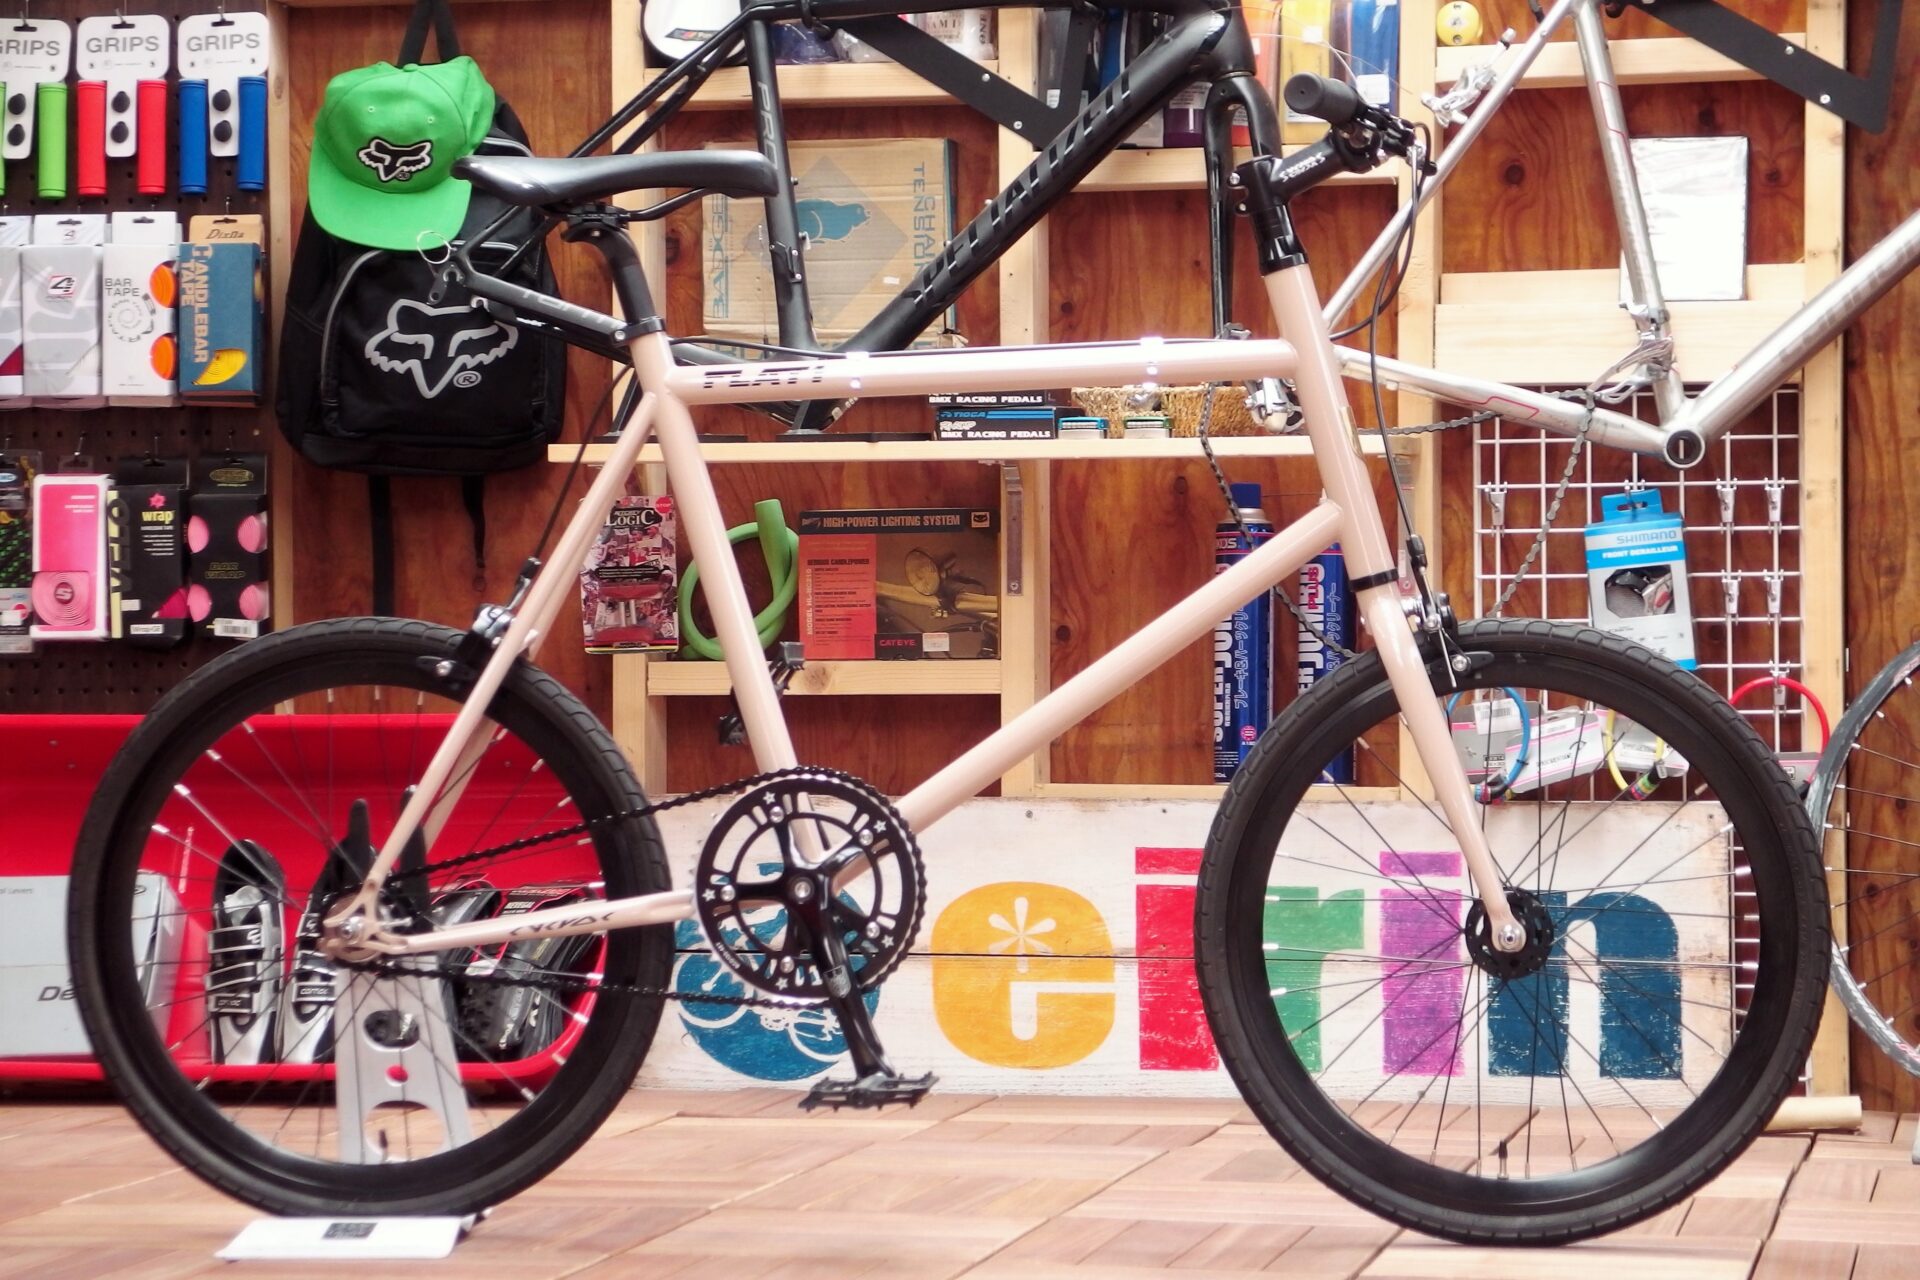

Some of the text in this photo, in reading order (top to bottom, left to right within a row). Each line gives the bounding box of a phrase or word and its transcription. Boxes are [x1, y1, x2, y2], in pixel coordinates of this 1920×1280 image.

[86, 36, 160, 53] GRIPS
[186, 33, 261, 52] GRIPS
[756, 81, 779, 169] PRO
[105, 278, 132, 287] BAR
[181, 258, 194, 307] TAPE
[105, 287, 140, 297] TAPE
[192, 244, 213, 363] HANDLEBAR
[955, 395, 996, 404] RACING
[1001, 394, 1043, 403] PEDALS
[967, 430, 1006, 439] RACING
[1010, 429, 1051, 438] PEDALS
[142, 510, 174, 526] wrap
[823, 515, 879, 528] HIGH-POWER
[881, 514, 923, 527] LIGHTING
[922, 513, 961, 526] SYSTEM
[1616, 529, 1678, 545] SHIMANO
[1307, 566, 1320, 610] PLUS
[879, 639, 917, 648] CATEYE
